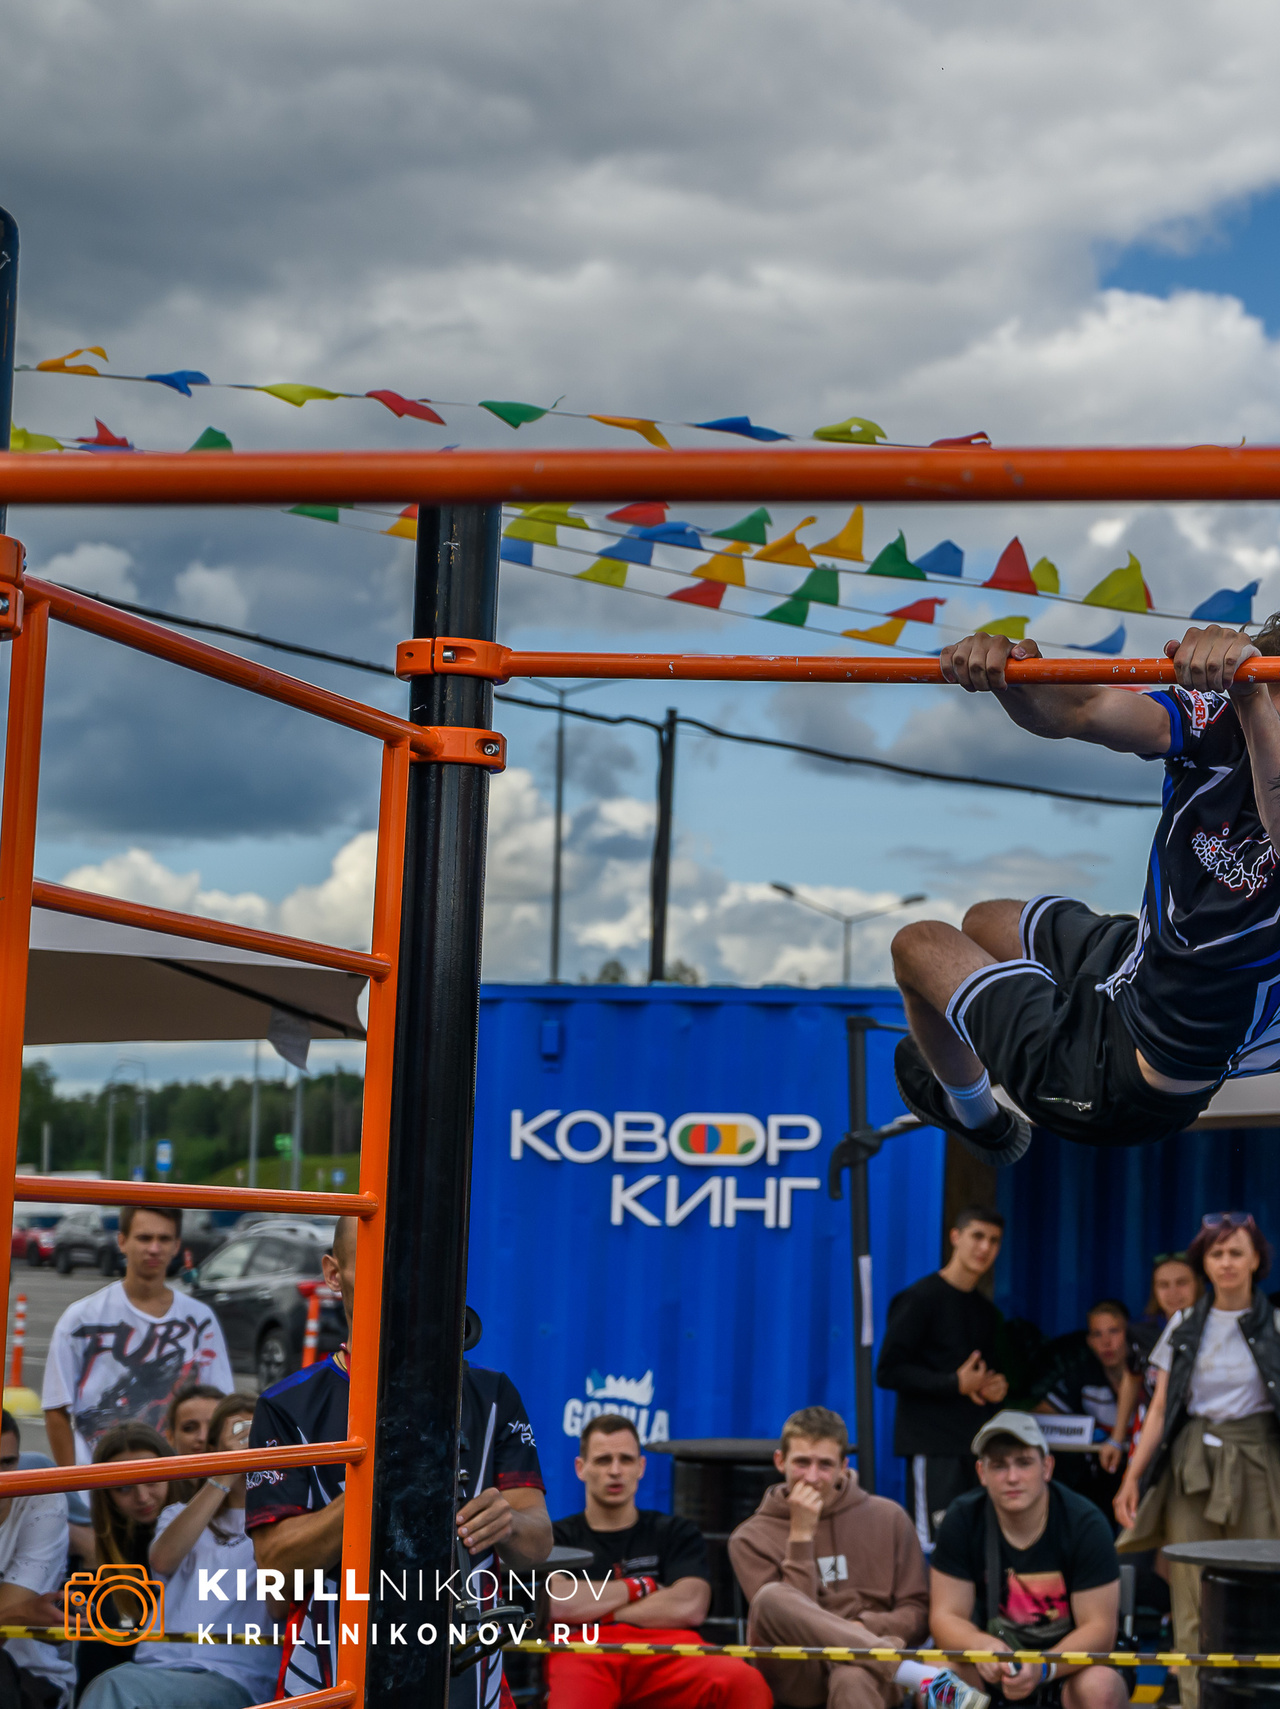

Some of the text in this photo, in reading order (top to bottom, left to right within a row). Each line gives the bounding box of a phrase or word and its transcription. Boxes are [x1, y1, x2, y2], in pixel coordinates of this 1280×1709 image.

[510, 1109, 822, 1166] КОВОР
[610, 1174, 821, 1229] КИНГ
[71, 1315, 212, 1400] FURY
